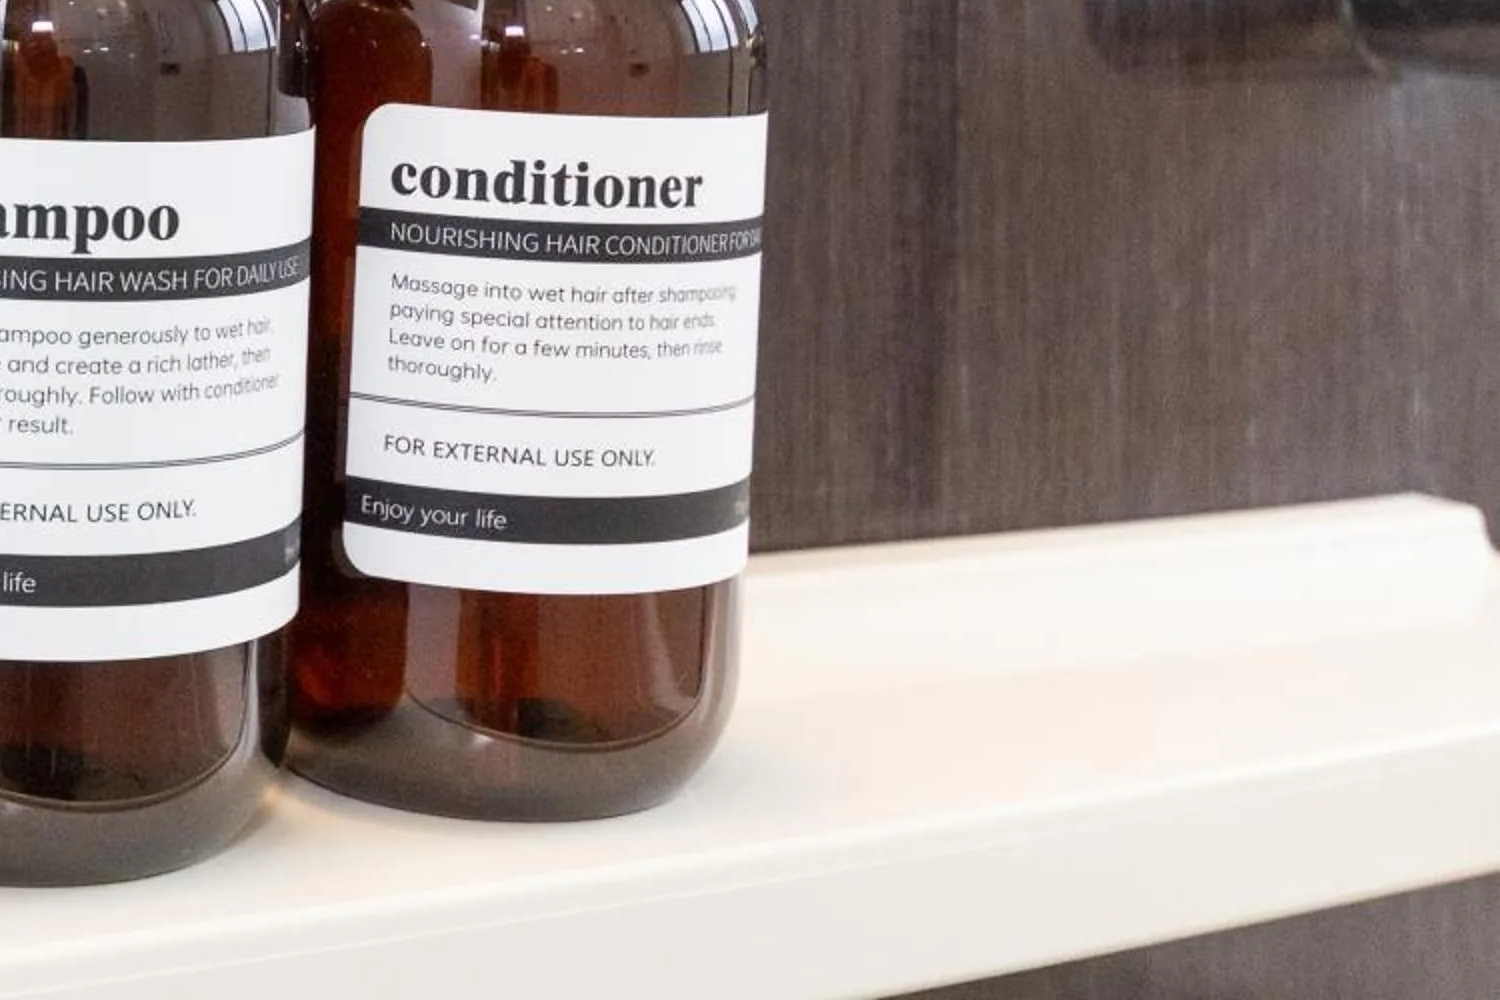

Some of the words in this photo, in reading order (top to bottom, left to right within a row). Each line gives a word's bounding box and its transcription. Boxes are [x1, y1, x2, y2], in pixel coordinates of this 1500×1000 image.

[391, 159, 704, 209] conditioner
[390, 222, 540, 253] NOURISHING
[546, 234, 599, 256] HAIR
[605, 229, 729, 256] CONDITIONER
[55, 269, 114, 292] HAIR
[120, 269, 187, 291] WASH
[194, 267, 232, 289] FOR
[236, 263, 277, 285] DAILY
[278, 255, 300, 279] USE
[390, 273, 478, 300] Massage
[485, 281, 521, 301] into
[528, 285, 564, 302] wet
[571, 284, 607, 303] hair
[612, 285, 654, 303] after
[389, 303, 454, 327] paying
[460, 308, 530, 329] special
[535, 311, 622, 331] attention
[628, 314, 644, 331] to
[650, 313, 677, 330] hair
[78, 324, 188, 349] generously
[194, 322, 211, 341] to
[215, 320, 244, 339] wet
[388, 329, 445, 352] Leave
[451, 334, 474, 352] on
[481, 334, 509, 356] for
[514, 341, 527, 357] a
[533, 338, 568, 358] few
[575, 339, 650, 360] minutes,
[656, 339, 690, 357] then
[693, 338, 722, 355] rinse
[7, 354, 49, 374] and
[55, 354, 122, 375] create
[128, 358, 141, 374] a
[147, 353, 181, 372] rich
[186, 350, 236, 372] lather,
[242, 346, 270, 364] then
[388, 356, 497, 384] thoroughly.
[90, 386, 154, 401] Follow
[161, 382, 199, 401] with
[204, 373, 279, 398] conditioner
[7, 415, 73, 435] result.
[384, 434, 425, 456] FOR
[433, 441, 546, 466] EXTERNAL
[554, 449, 594, 467] USE
[601, 449, 655, 467] ONLY.
[87, 503, 129, 522] USE
[137, 499, 196, 520] ONLY.
[361, 495, 415, 524] Enjoy
[420, 505, 468, 528] your
[475, 508, 508, 530] life
[3, 571, 37, 594] life
